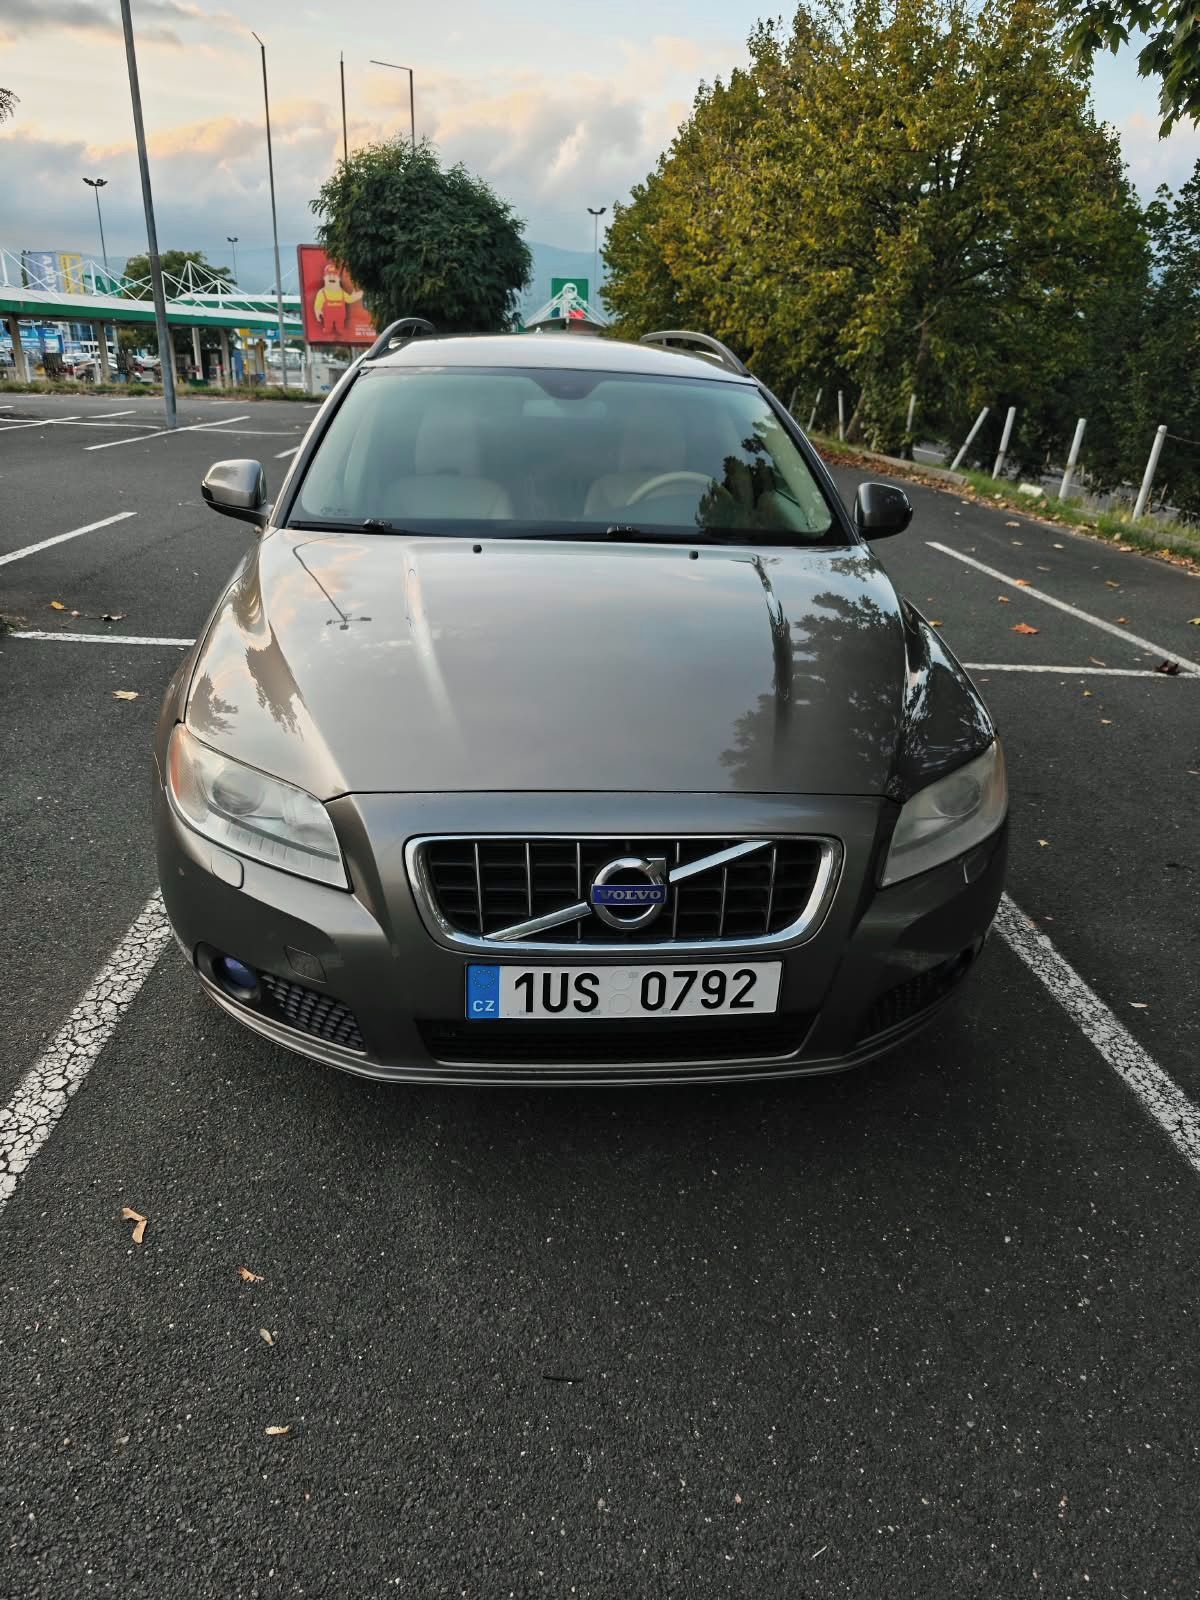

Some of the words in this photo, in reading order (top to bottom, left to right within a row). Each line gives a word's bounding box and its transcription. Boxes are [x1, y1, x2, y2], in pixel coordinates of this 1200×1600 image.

[514, 972, 600, 1013] 1US
[640, 968, 758, 1011] 0792
[472, 1000, 495, 1013] CZ
